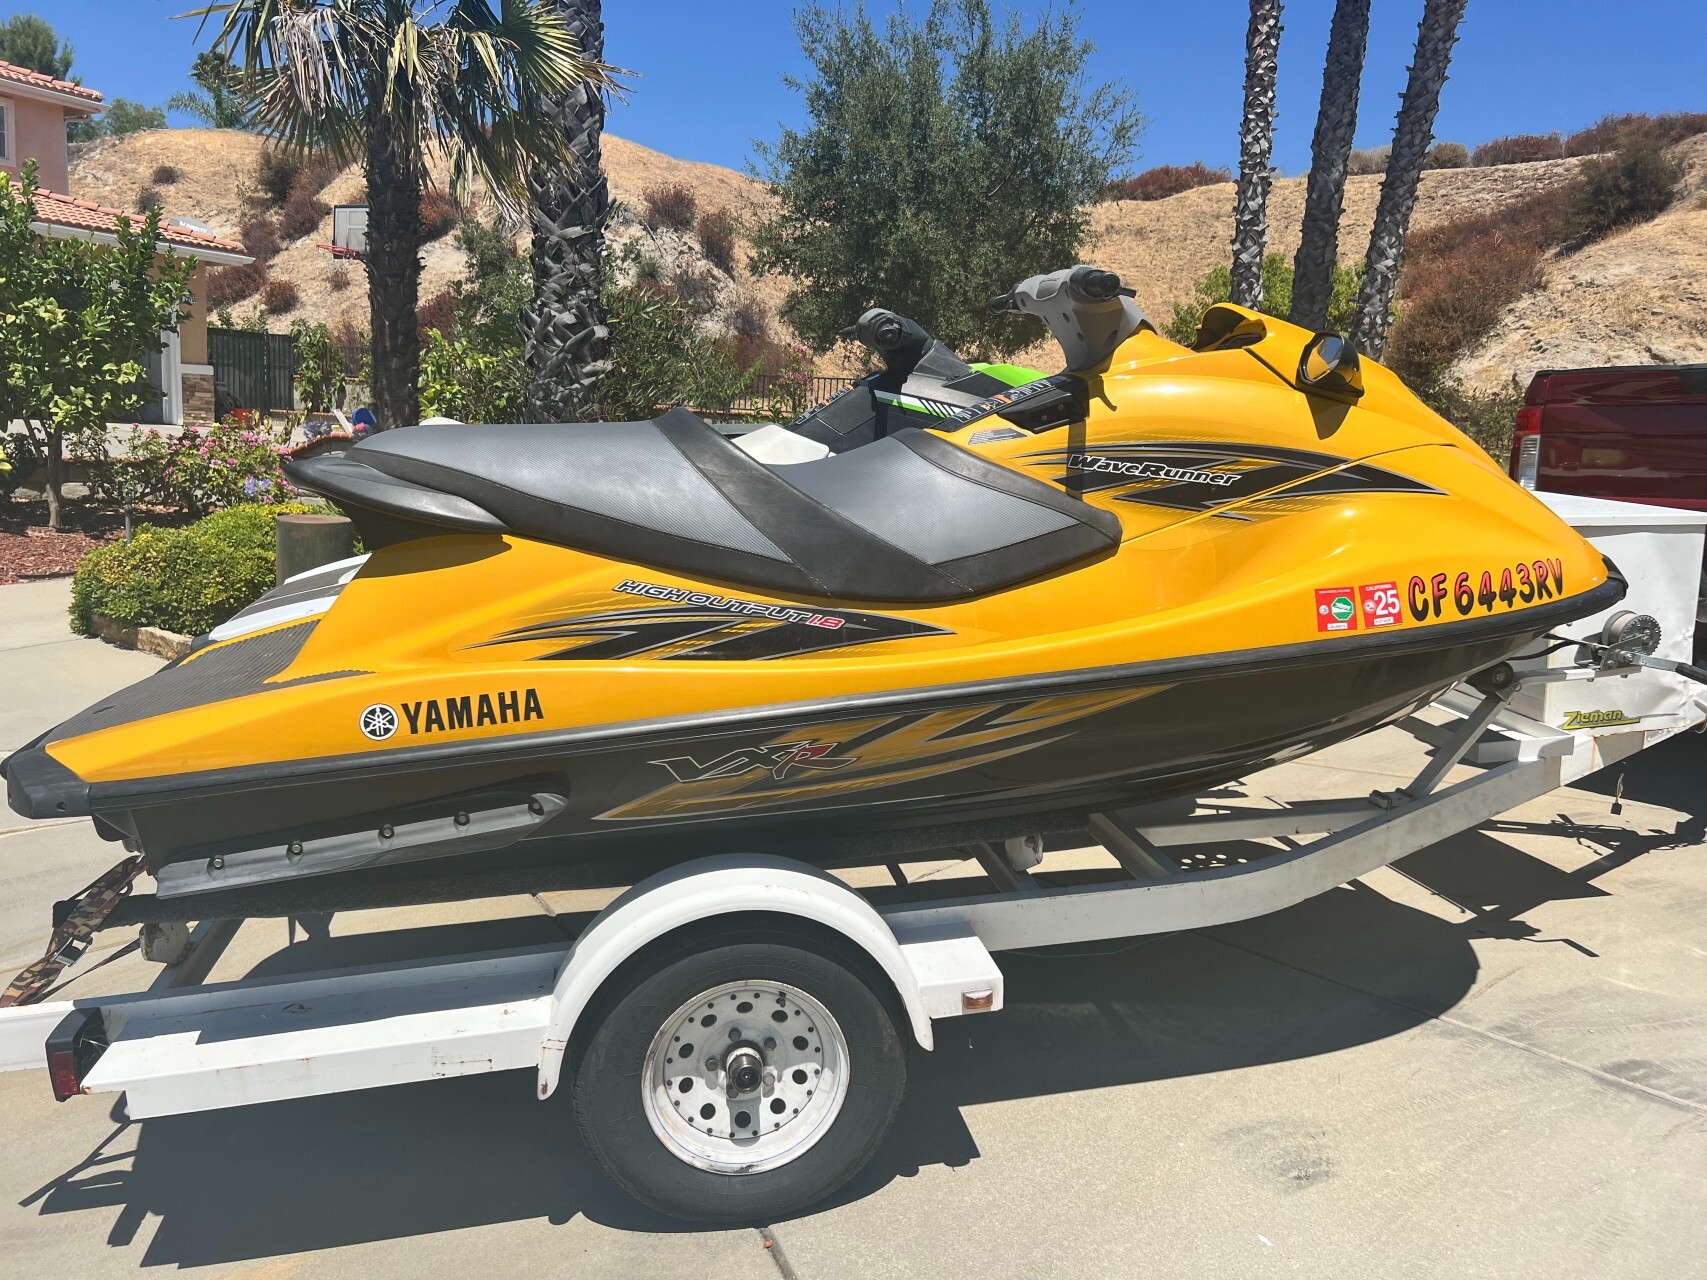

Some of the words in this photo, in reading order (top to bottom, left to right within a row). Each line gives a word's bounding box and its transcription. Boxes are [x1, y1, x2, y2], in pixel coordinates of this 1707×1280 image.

[1067, 454, 1242, 487] WaveRunner
[1373, 589, 1400, 616] 25
[1408, 573, 1448, 622] CF
[1454, 558, 1563, 616] 6443RV
[401, 688, 544, 735] YAMAHA
[1562, 710, 1640, 730] Zieman
